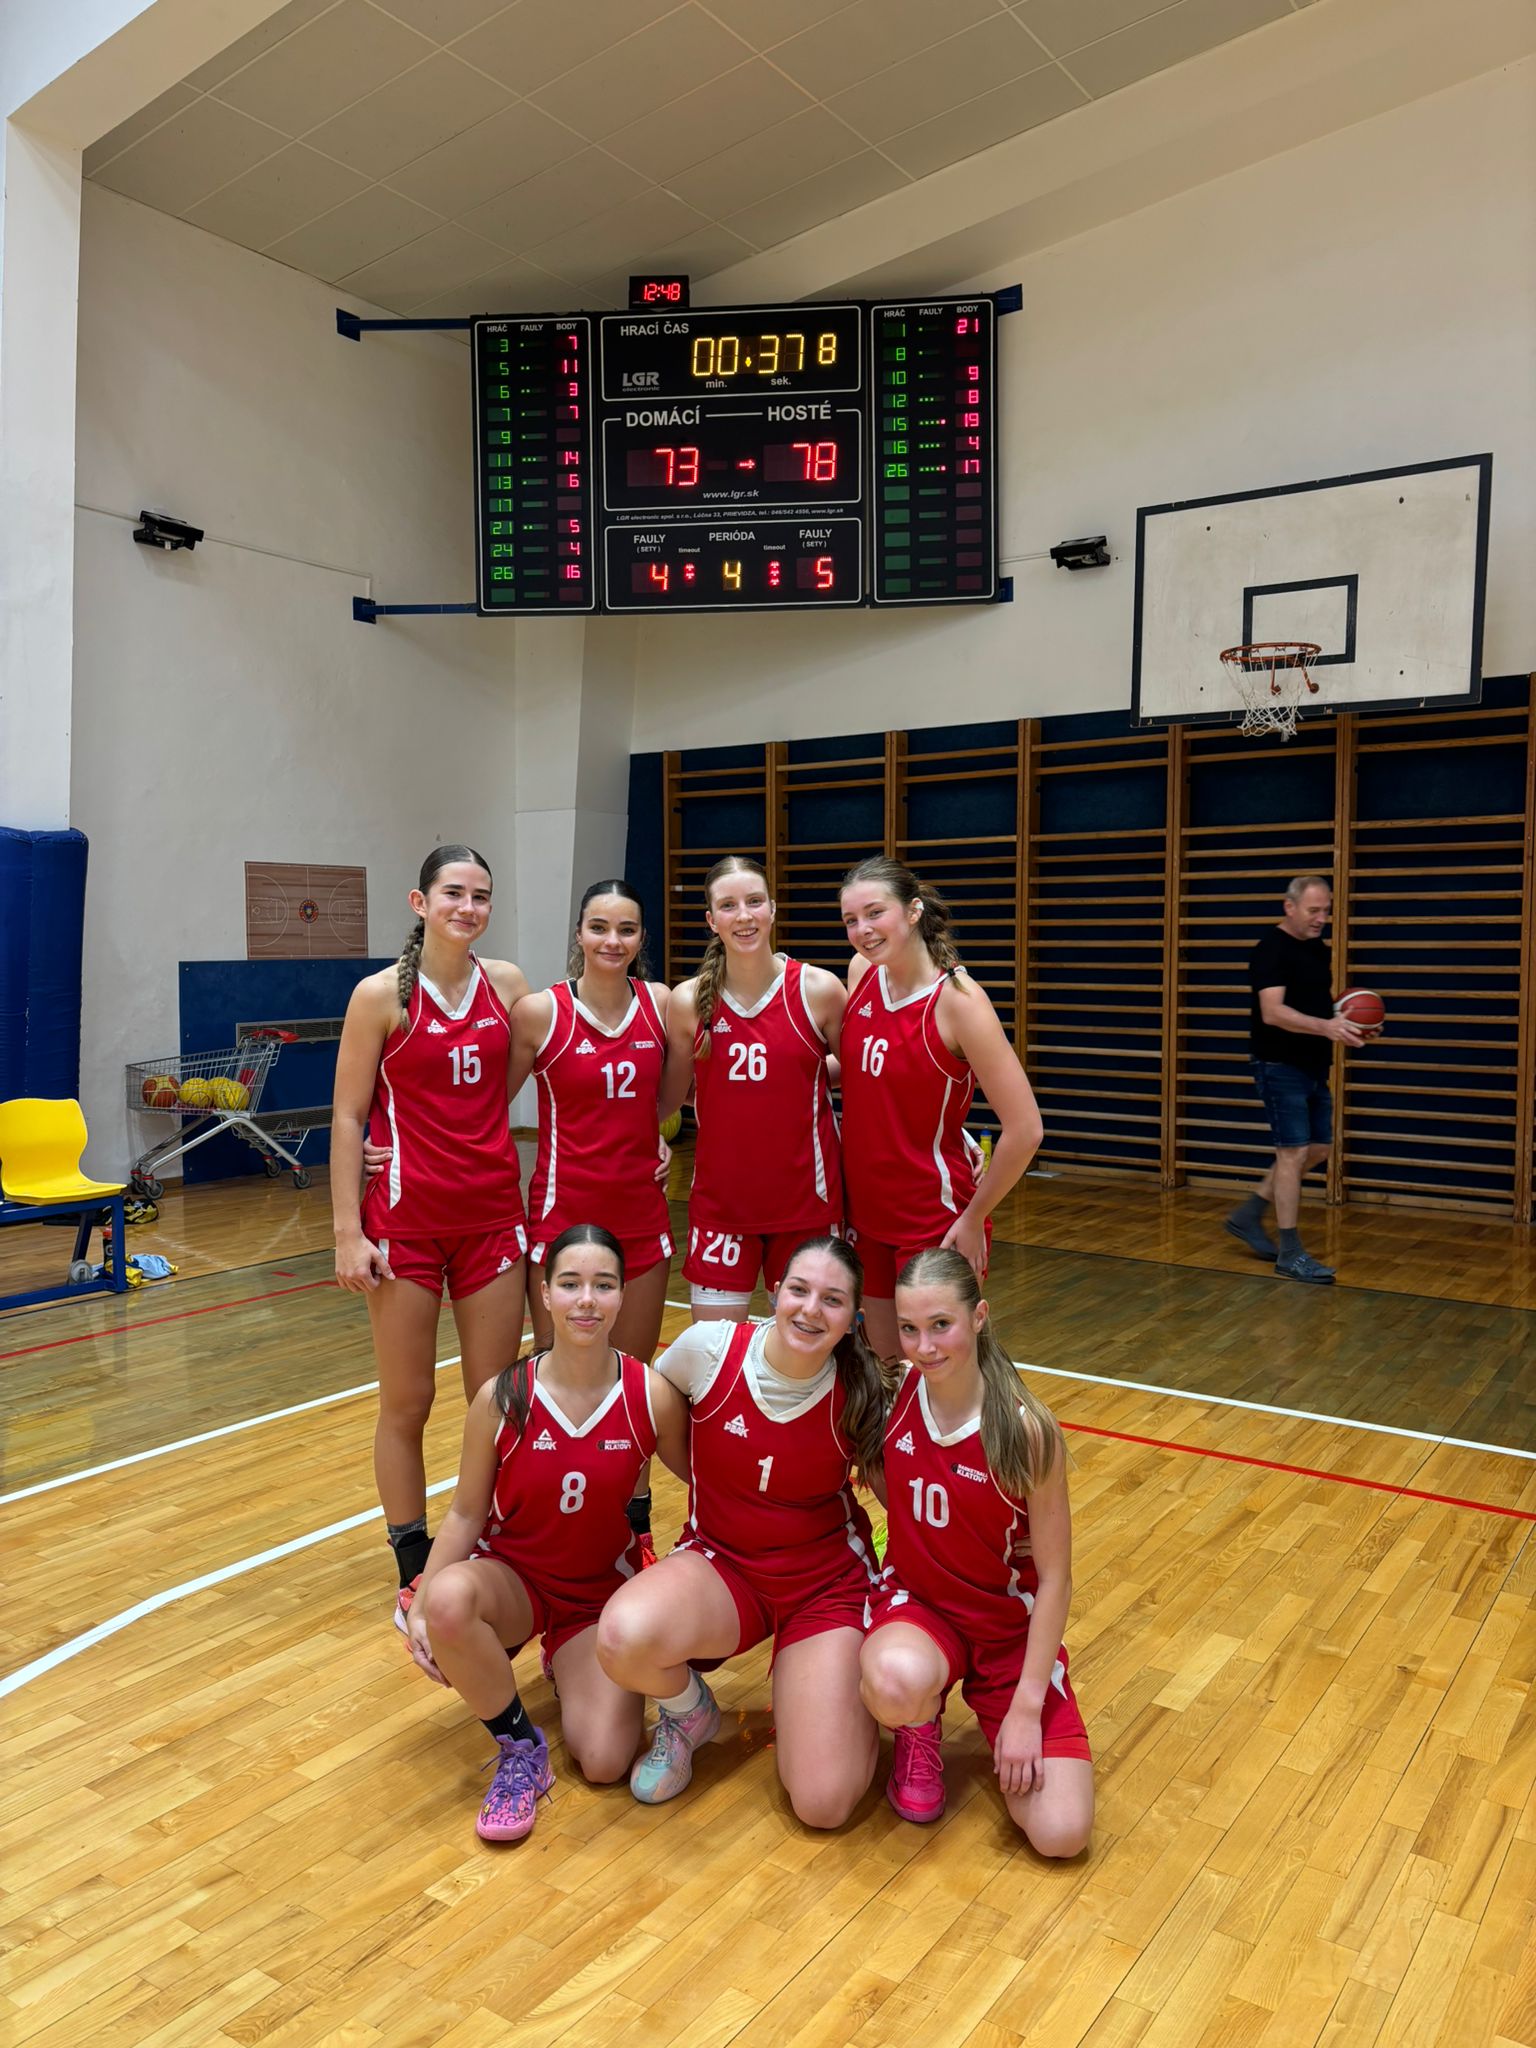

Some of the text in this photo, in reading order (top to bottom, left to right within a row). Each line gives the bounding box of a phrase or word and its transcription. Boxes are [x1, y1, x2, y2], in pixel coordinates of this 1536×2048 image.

[644, 283, 680, 301] 12:48
[883, 309, 905, 318] HRÁČ
[956, 305, 978, 313] BODY
[487, 324, 508, 333] HRÁČ
[620, 321, 689, 336] HRACÍ ČAS
[957, 319, 978, 334] 21
[500, 336, 578, 352] 3 7
[819, 333, 836, 364] 8
[896, 347, 906, 361] 8
[500, 359, 578, 375] 5 11
[622, 372, 659, 386] LGR
[705, 376, 792, 389] min. sek.
[892, 366, 979, 385] 10 9
[500, 382, 578, 399] 6 3
[893, 389, 979, 408] 12 8
[502, 405, 579, 421] 7 7
[626, 401, 832, 427] DOMÁCÍ HOSTÉ
[893, 413, 979, 431] 15 19
[501, 431, 511, 444] 9
[893, 436, 979, 454] 16 4
[498, 451, 579, 467] 11 14
[655, 442, 837, 486] 73 78
[886, 459, 979, 478] 26 17
[498, 474, 579, 489] 13 6
[702, 489, 760, 500] www.lgr.sk
[498, 499, 512, 512] 17
[492, 519, 580, 535] 21 5
[633, 529, 832, 544] FAULY PERIÓDA FAULY
[493, 542, 580, 557] 24 4
[493, 565, 581, 580] 26 16
[651, 556, 833, 591] 4 4 5
[728, 1042, 767, 1081] 26
[861, 1034, 889, 1078] 16
[448, 1044, 481, 1086] 15
[601, 1061, 636, 1099] 12
[702, 1231, 743, 1267] 26
[723, 1421, 750, 1439] PEAK
[532, 1441, 557, 1450] PEAK
[895, 1439, 916, 1456] PEAK
[758, 1455, 774, 1492] 1
[956, 1469, 988, 1484] KLATOVY
[560, 1471, 587, 1514] 8
[908, 1476, 950, 1528] 10
